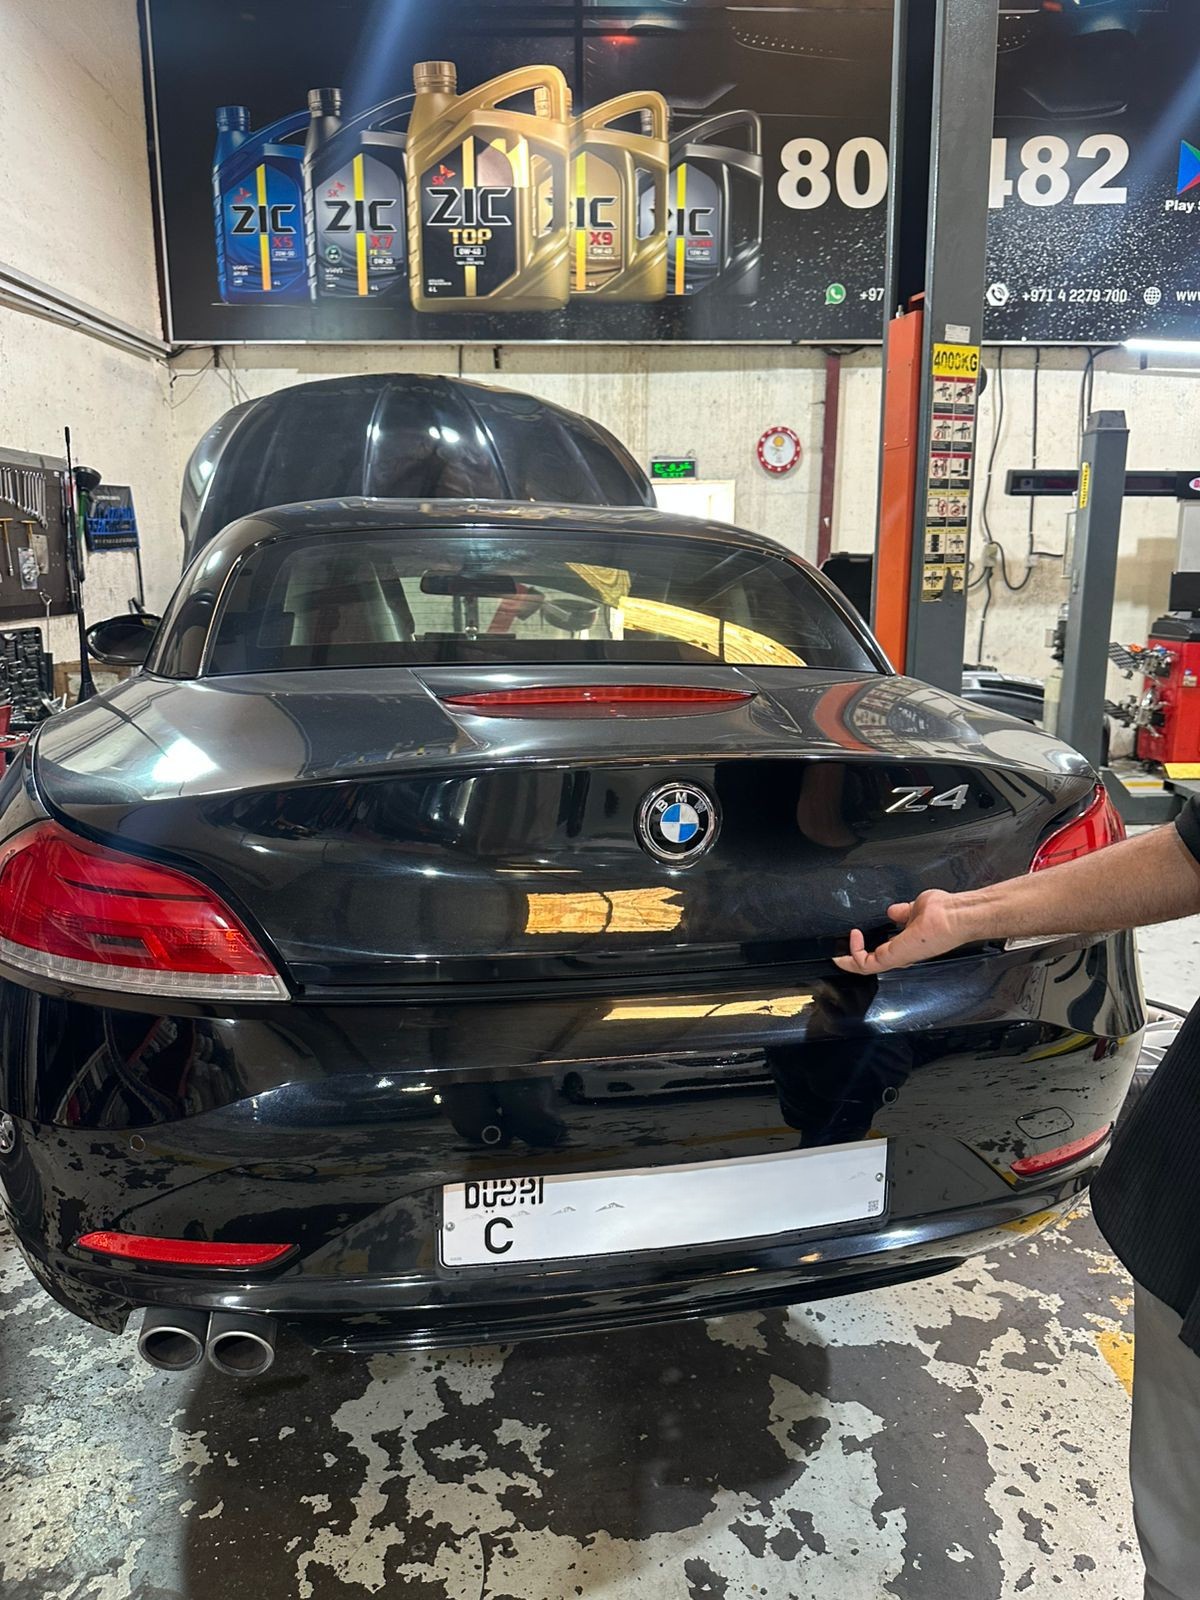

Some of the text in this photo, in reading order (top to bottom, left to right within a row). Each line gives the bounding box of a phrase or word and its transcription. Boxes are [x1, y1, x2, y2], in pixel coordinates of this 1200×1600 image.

[777, 136, 889, 210] 80
[323, 199, 397, 232] ZIC
[425, 187, 512, 226] ZIC
[1164, 199, 1195, 214] Play
[230, 204, 296, 234] ZIC
[272, 235, 293, 248] X5
[369, 234, 393, 248] X7
[448, 228, 492, 245] TOP
[590, 231, 613, 246] X9
[860, 287, 885, 302] +97
[1022, 288, 1128, 303] +971 4 2279 700
[655, 791, 708, 814] BMW
[885, 784, 969, 813] Z4
[484, 1216, 514, 1255] C
